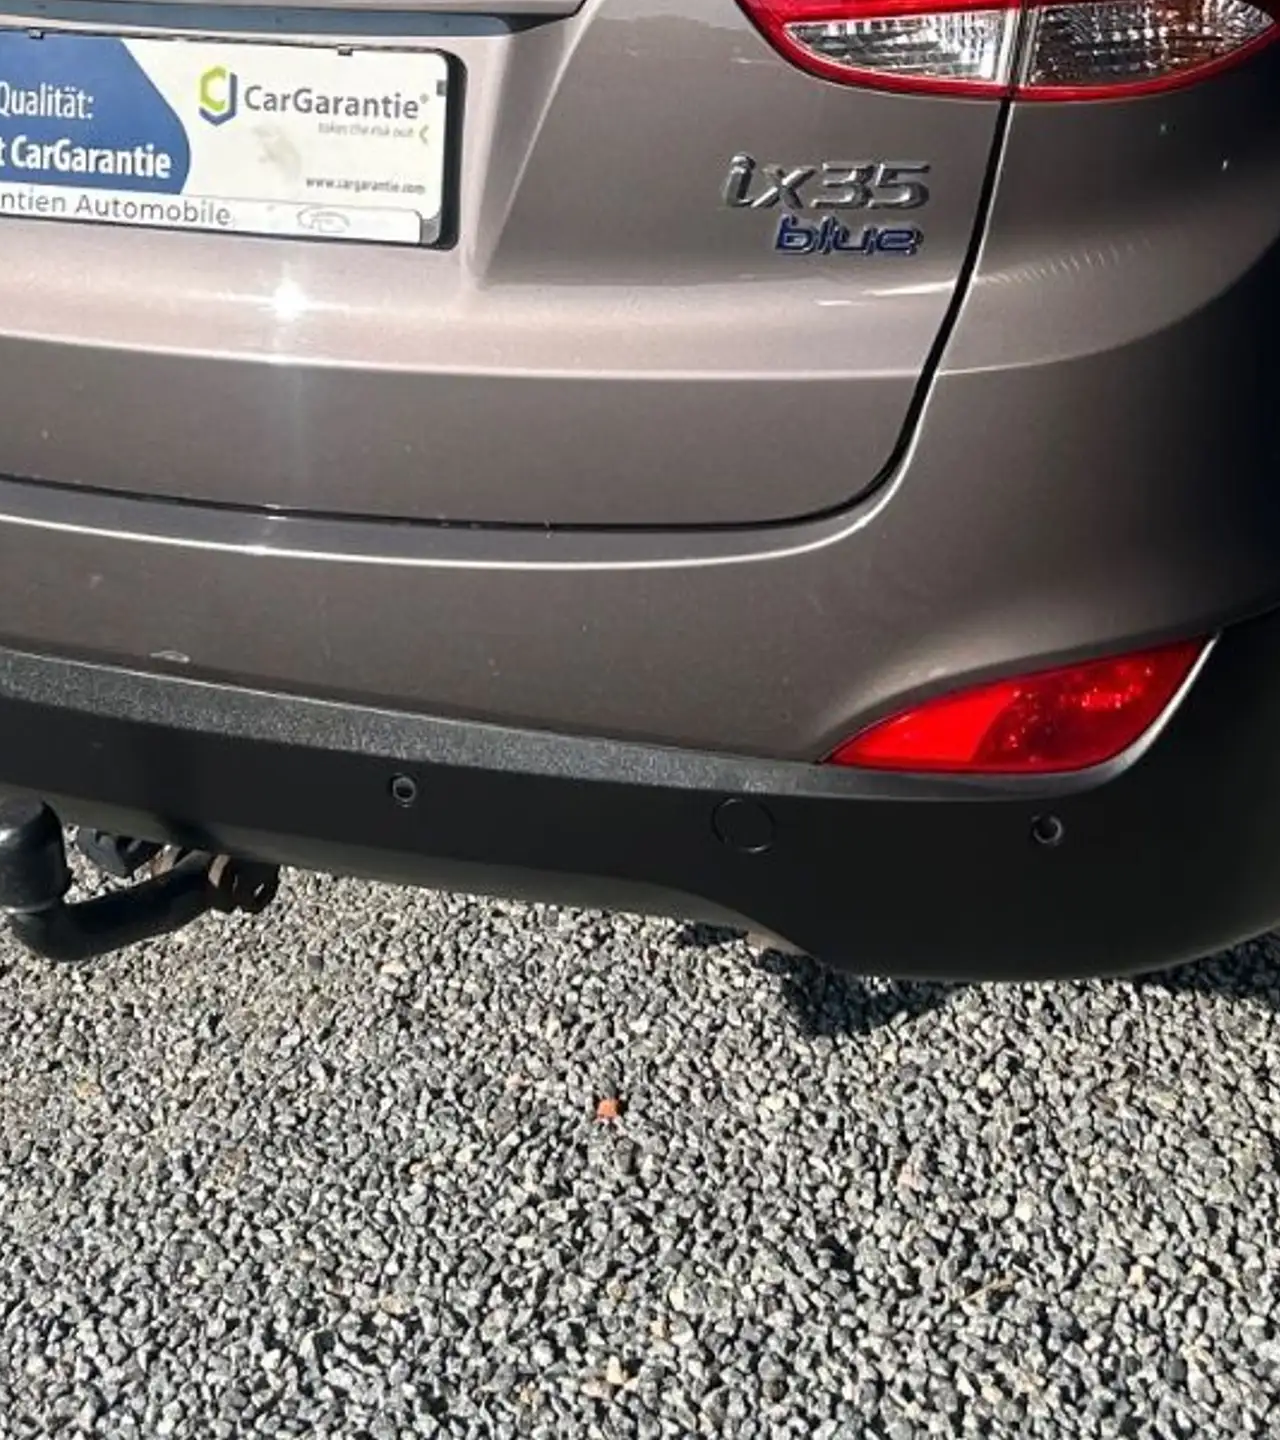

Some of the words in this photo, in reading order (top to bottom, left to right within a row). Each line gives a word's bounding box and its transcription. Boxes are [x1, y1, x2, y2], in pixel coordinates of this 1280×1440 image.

[244, 85, 419, 119] CarGarantie
[11, 134, 172, 179] CarGarantie
[723, 151, 932, 211] ix35
[74, 194, 231, 227] Automobile
[775, 212, 925, 256] blue
